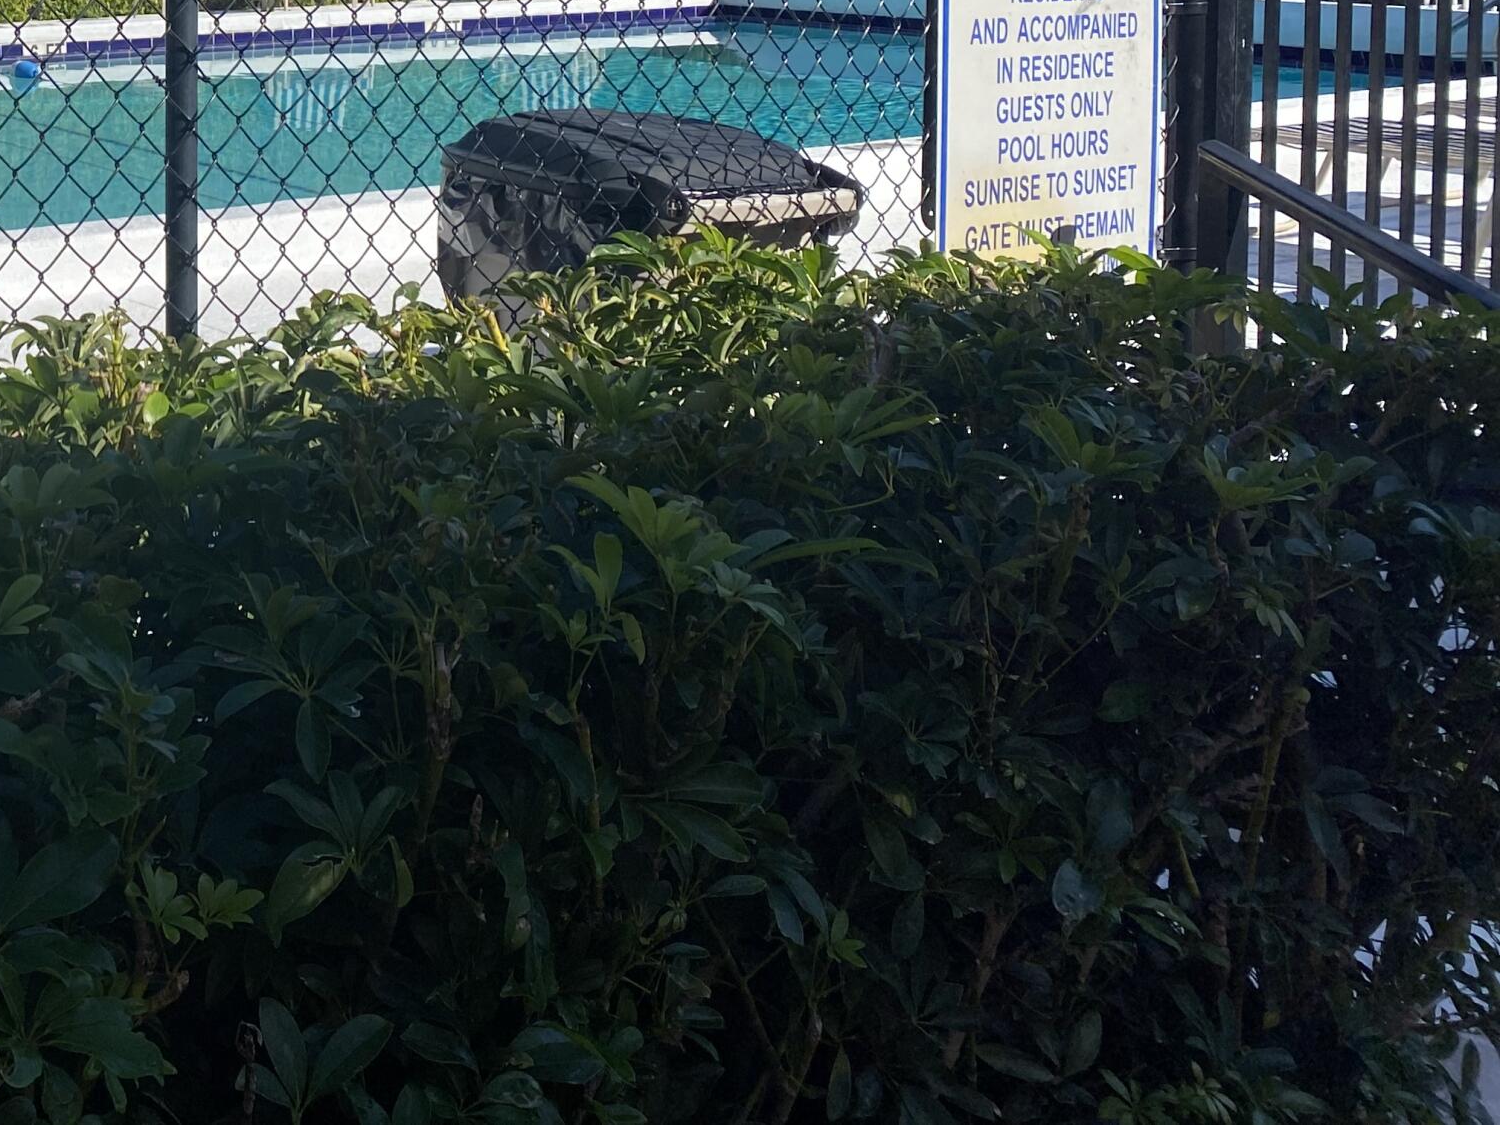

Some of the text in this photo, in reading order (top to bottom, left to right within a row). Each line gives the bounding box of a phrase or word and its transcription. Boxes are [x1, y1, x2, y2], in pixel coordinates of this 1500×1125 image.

[970, 12, 1138, 45] AND ACCOMPANIED
[997, 52, 1114, 84] IN RESIDENCE
[997, 90, 1113, 124] GUESTS ONLY
[998, 129, 1109, 164] POOL HOURS
[964, 164, 1137, 208] SUNRISE TO SUNSET
[965, 221, 1012, 252] GATE
[1075, 208, 1135, 239] REMAIN
